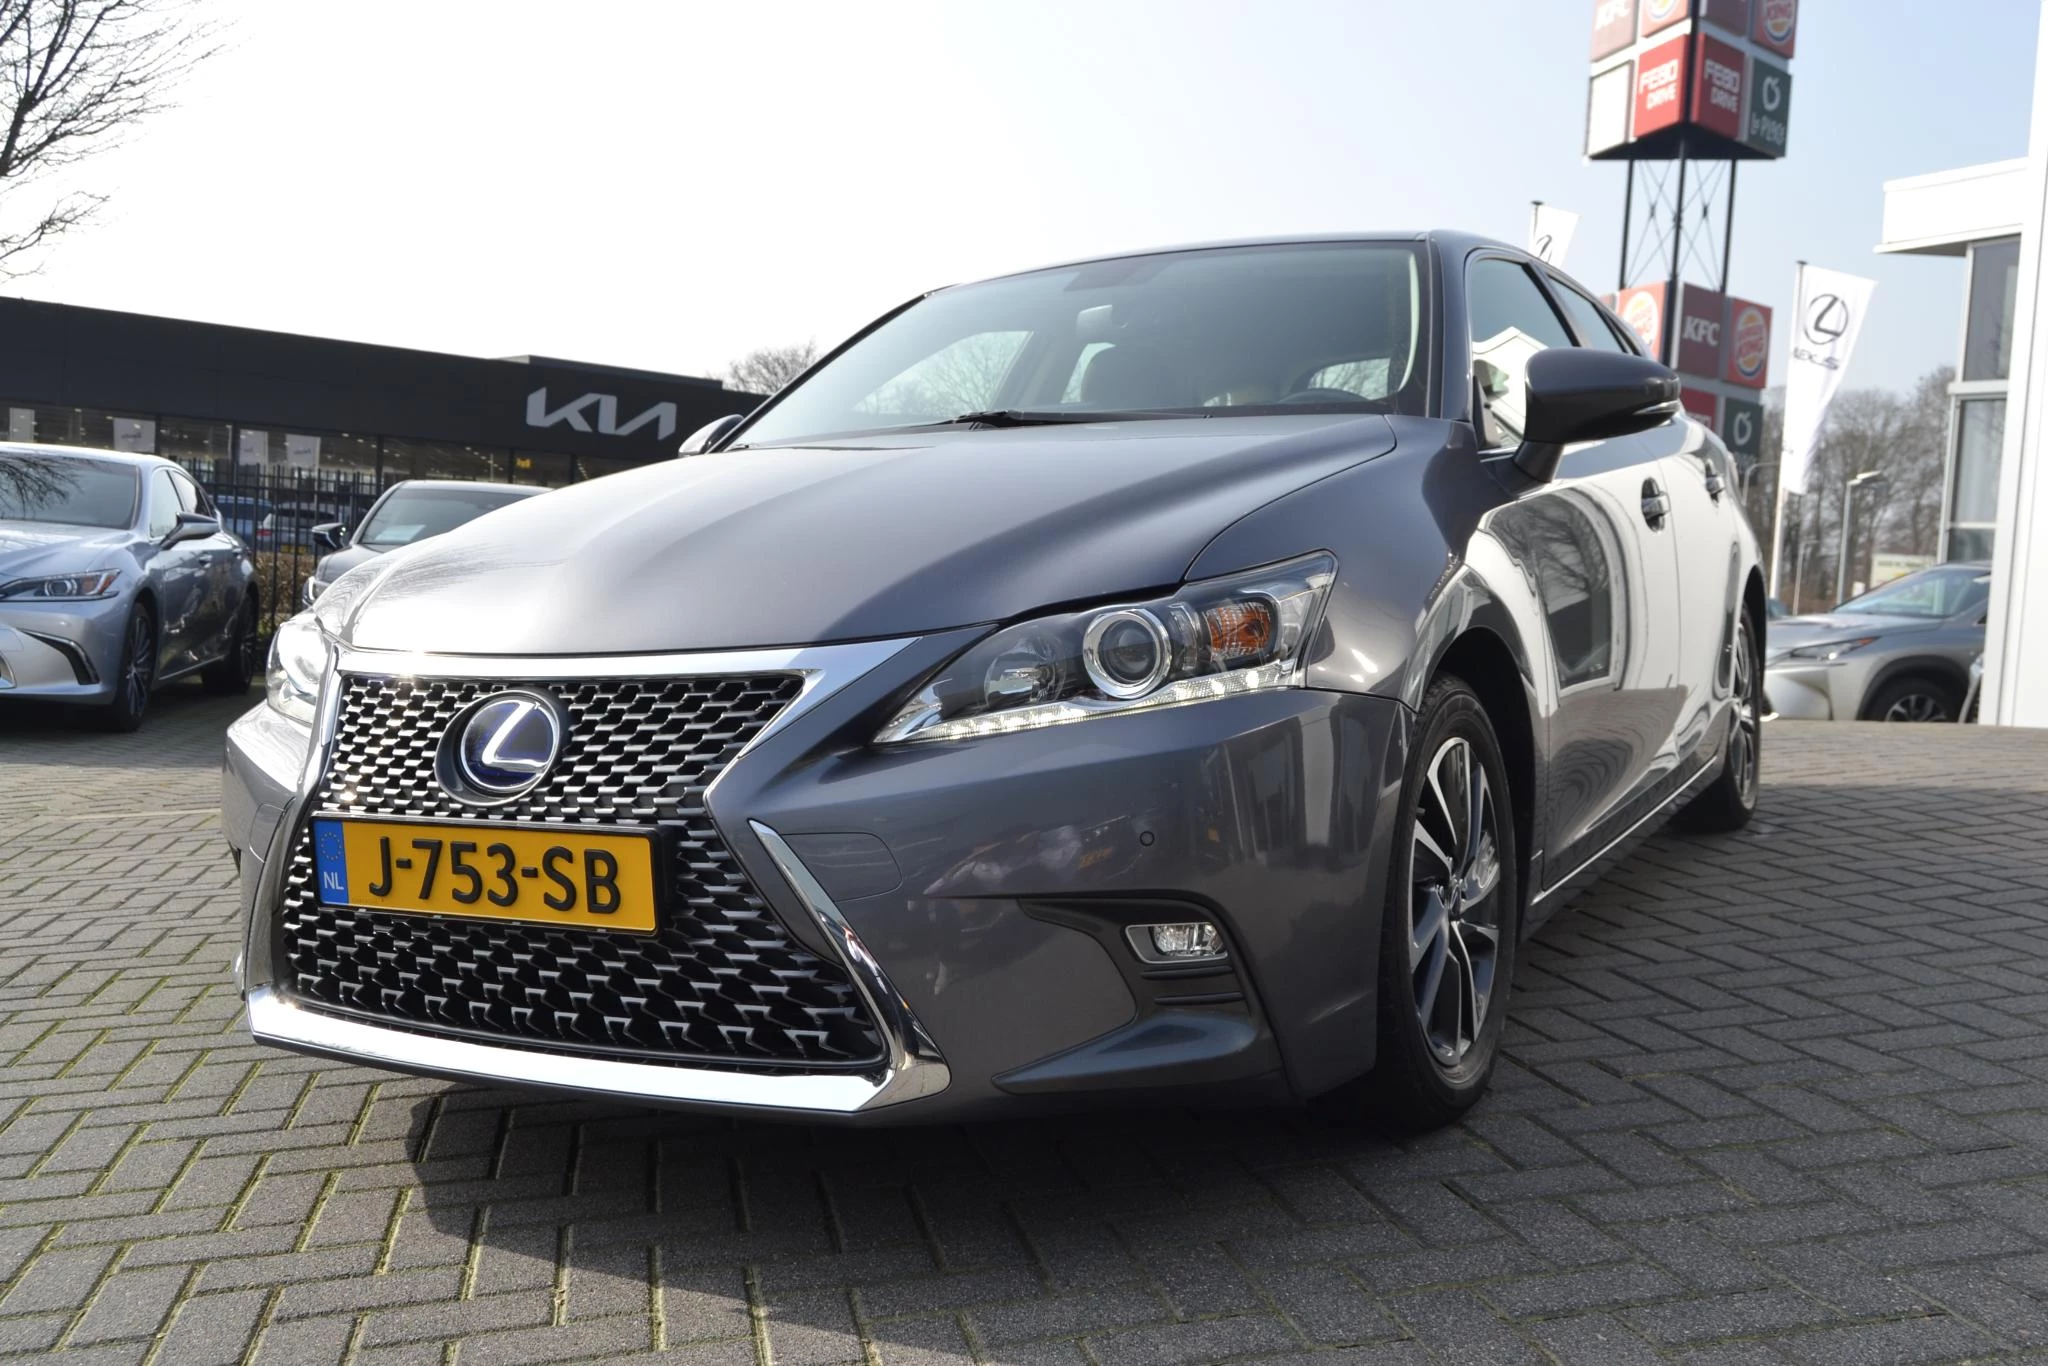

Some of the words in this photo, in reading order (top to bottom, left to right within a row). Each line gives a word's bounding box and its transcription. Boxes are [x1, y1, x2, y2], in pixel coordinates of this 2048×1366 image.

[1646, 82, 1677, 110] DRIVE
[1710, 86, 1738, 113] DRIVE
[1682, 315, 1720, 347] KFC
[526, 387, 677, 441] KIA
[323, 870, 345, 892] NL
[369, 836, 621, 915] J-753-SB
